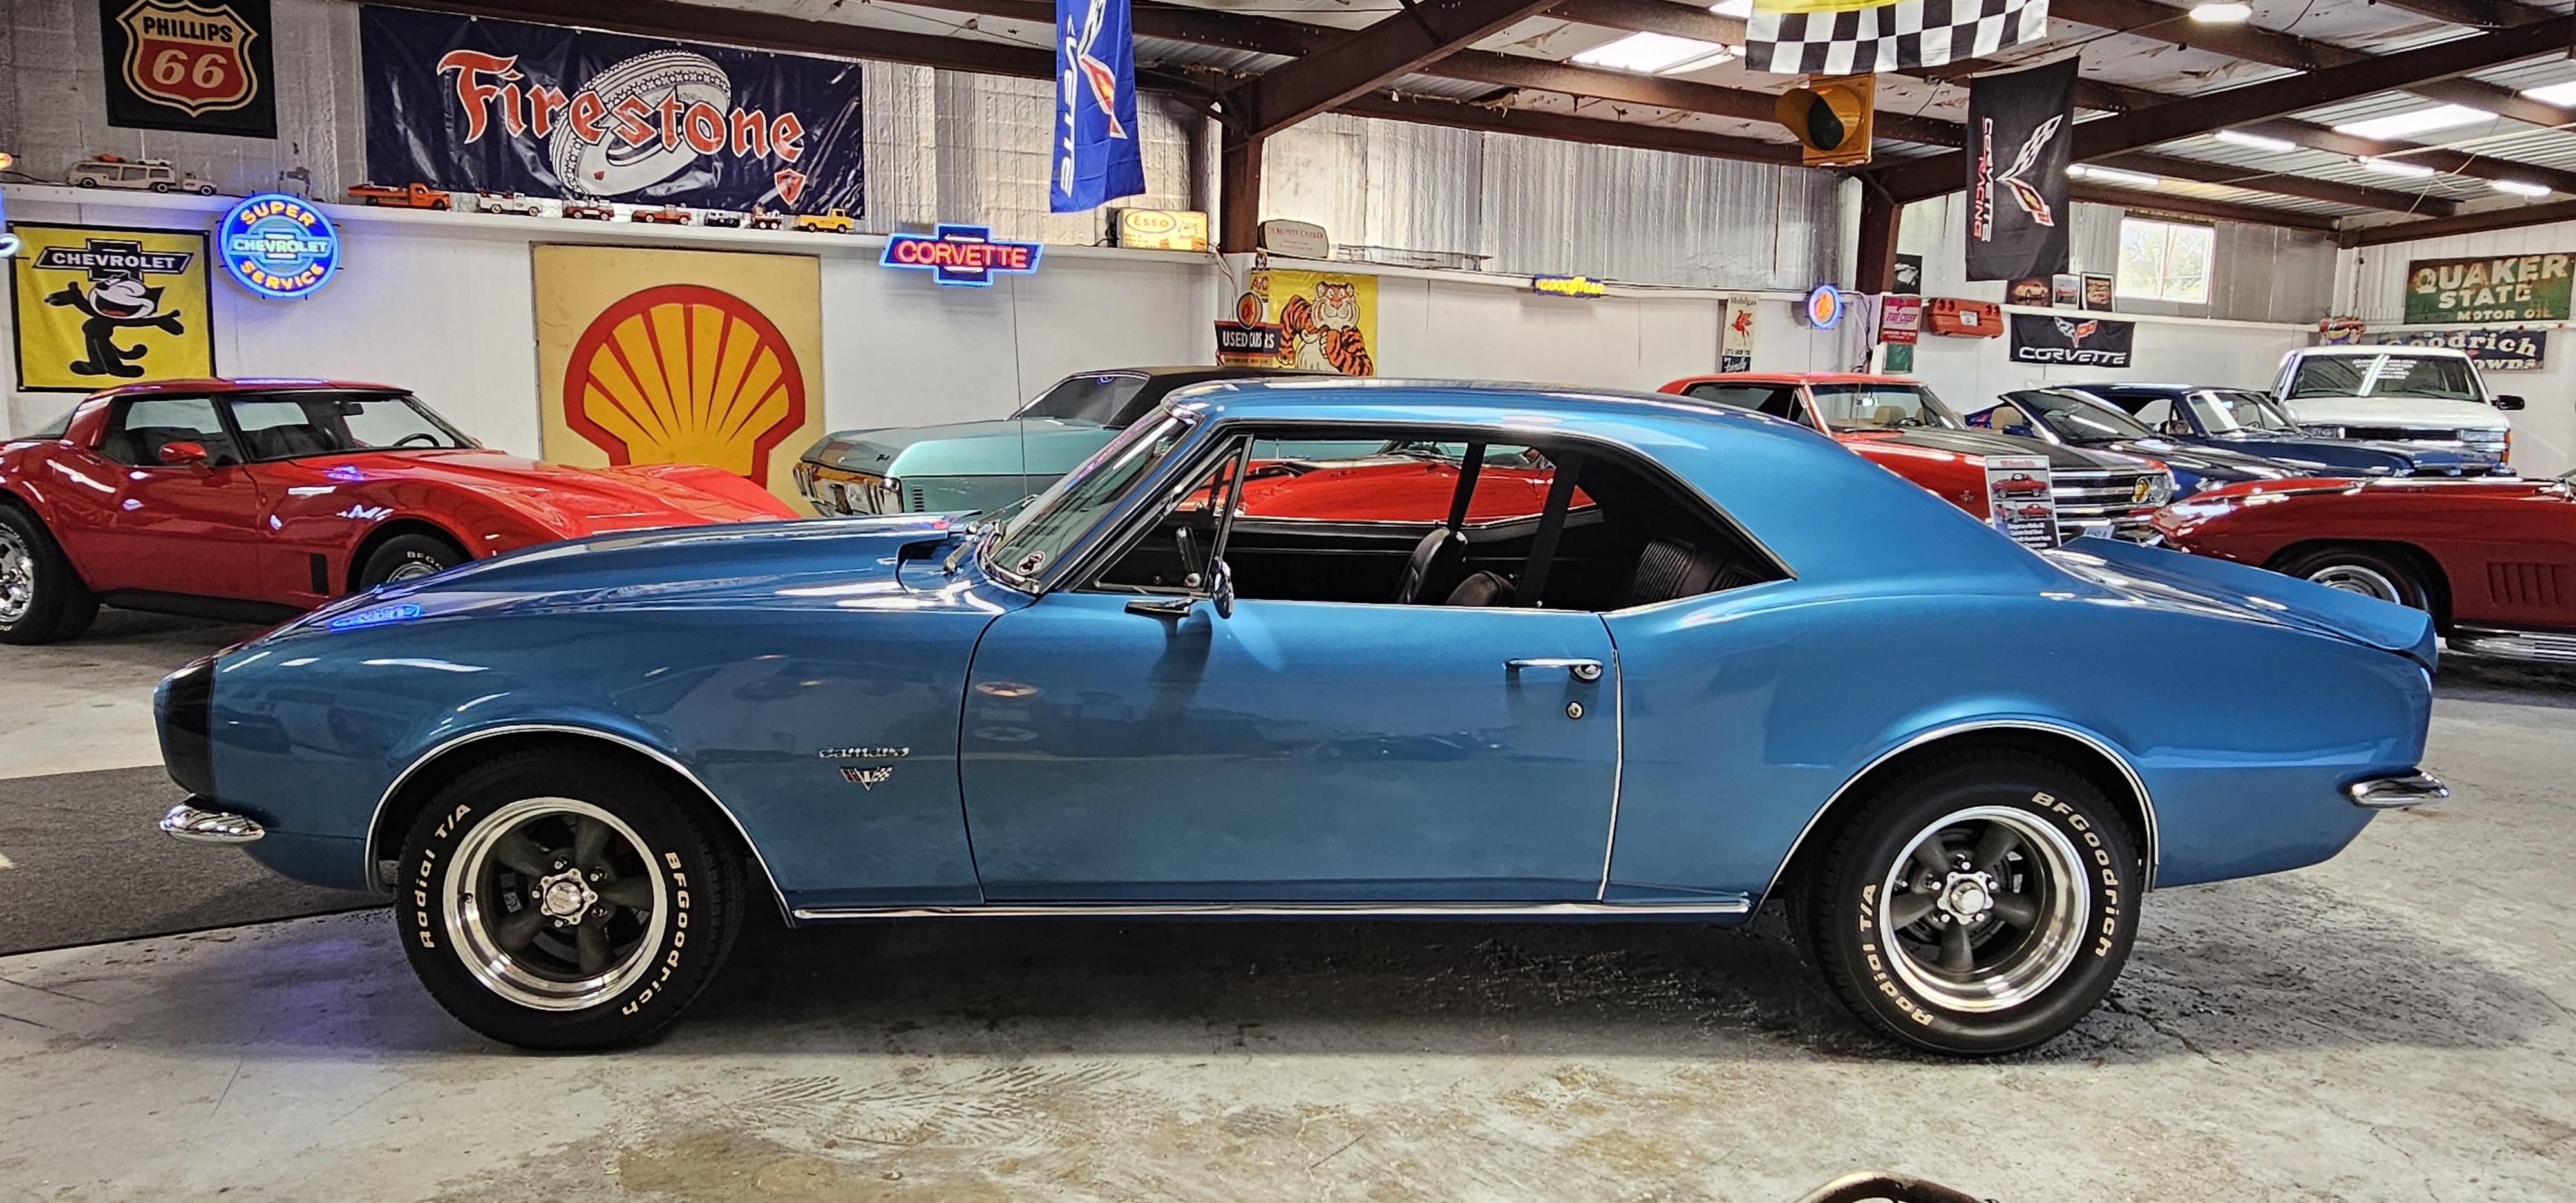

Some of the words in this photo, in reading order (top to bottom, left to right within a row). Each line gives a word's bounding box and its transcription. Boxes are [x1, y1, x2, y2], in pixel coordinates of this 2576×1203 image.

[143, 15, 233, 43] PHILLIPS
[153, 50, 227, 88] 66
[437, 49, 805, 163] Firestone
[240, 201, 316, 227] SUPER
[52, 252, 177, 269] CHEVROLET
[233, 239, 328, 254] CHEVROLET
[895, 240, 1027, 268] CORVETTE
[240, 260, 325, 290] SERVICE
[2412, 254, 2568, 294] QUAKER
[2438, 284, 2533, 308] STATE
[2457, 310, 2515, 321] MOTOR
[1222, 330, 1248, 347] USED
[2019, 346, 2126, 365] CORVETTE
[414, 849, 435, 948] Radial
[435, 804, 472, 840] T/A
[2031, 791, 2119, 957] BFGoodrich
[1859, 884, 1877, 932] T/A
[621, 851, 690, 1016] BFGoodrich
[1862, 944, 1935, 1026] Radial
